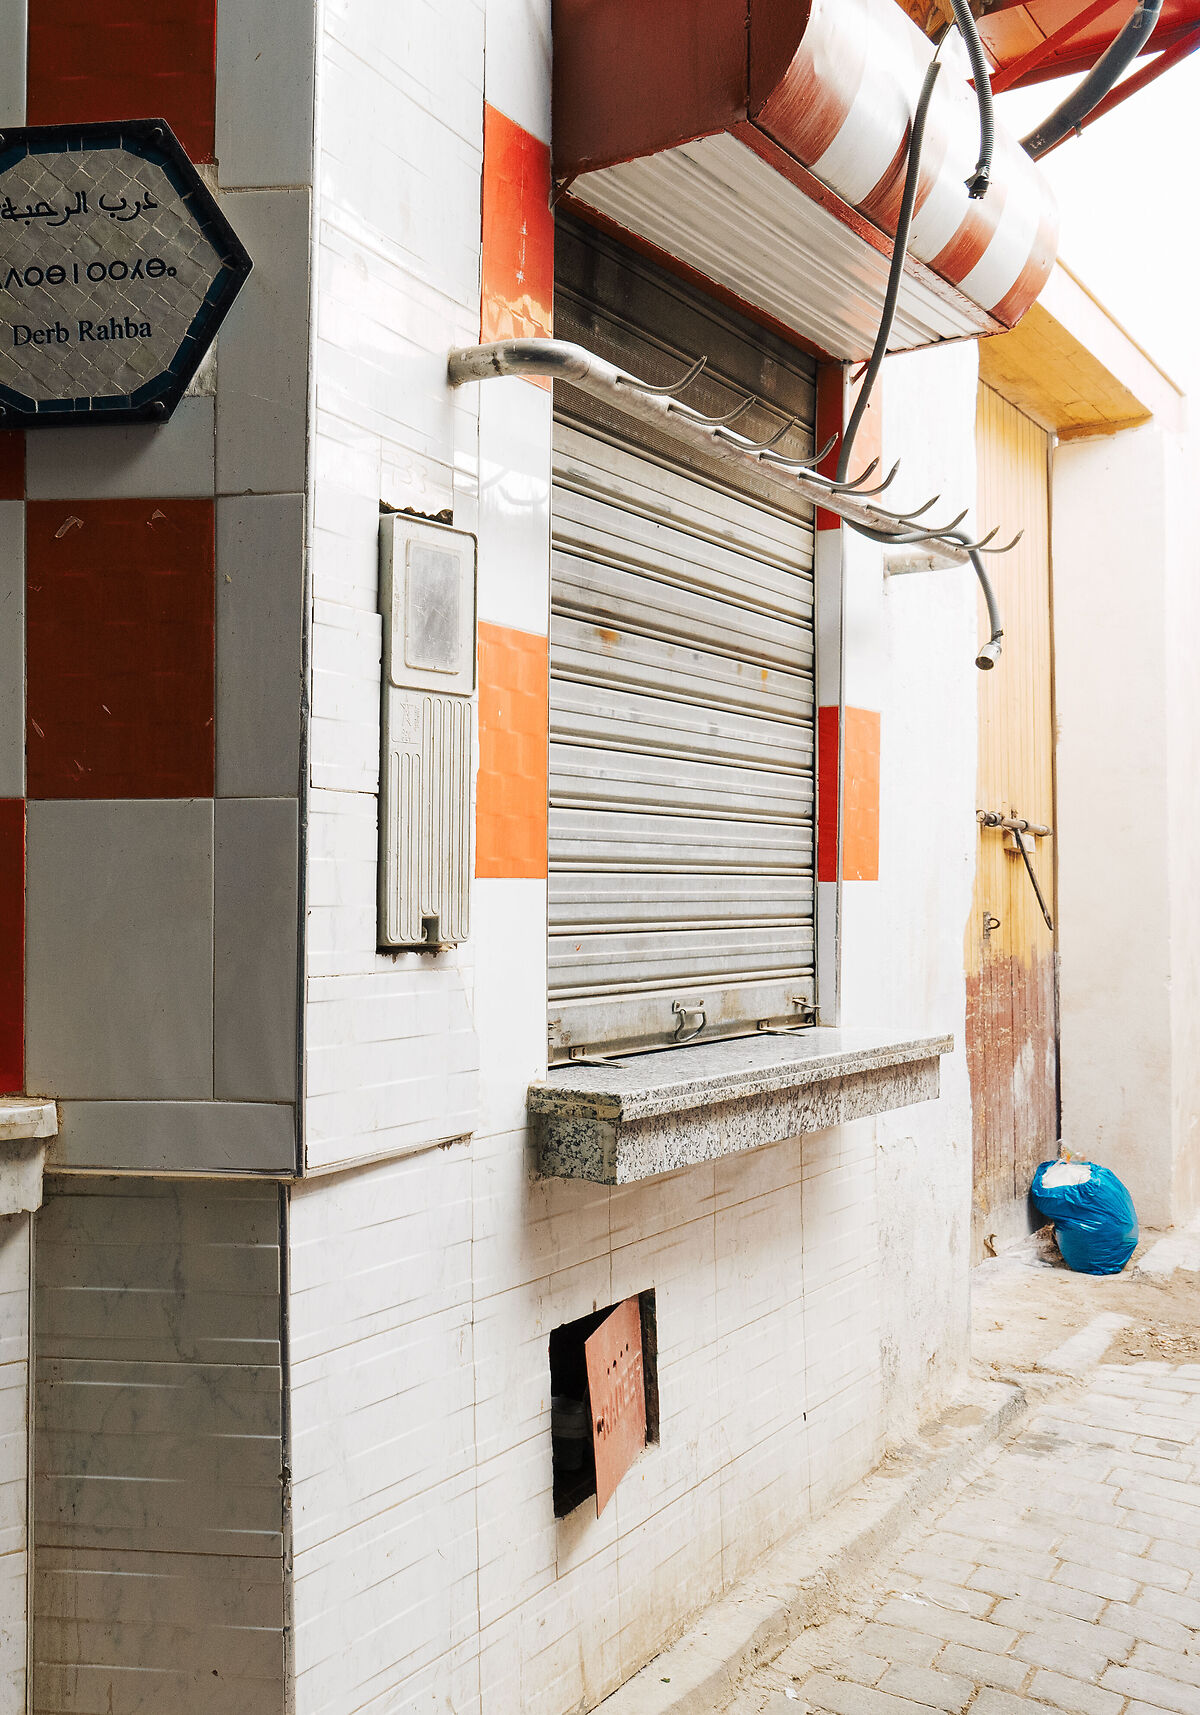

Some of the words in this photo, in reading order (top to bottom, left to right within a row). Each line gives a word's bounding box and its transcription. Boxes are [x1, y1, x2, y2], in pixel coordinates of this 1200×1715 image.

[98, 190, 158, 222] درب
[12, 320, 70, 346] Derb
[77, 316, 152, 342] Rahba
